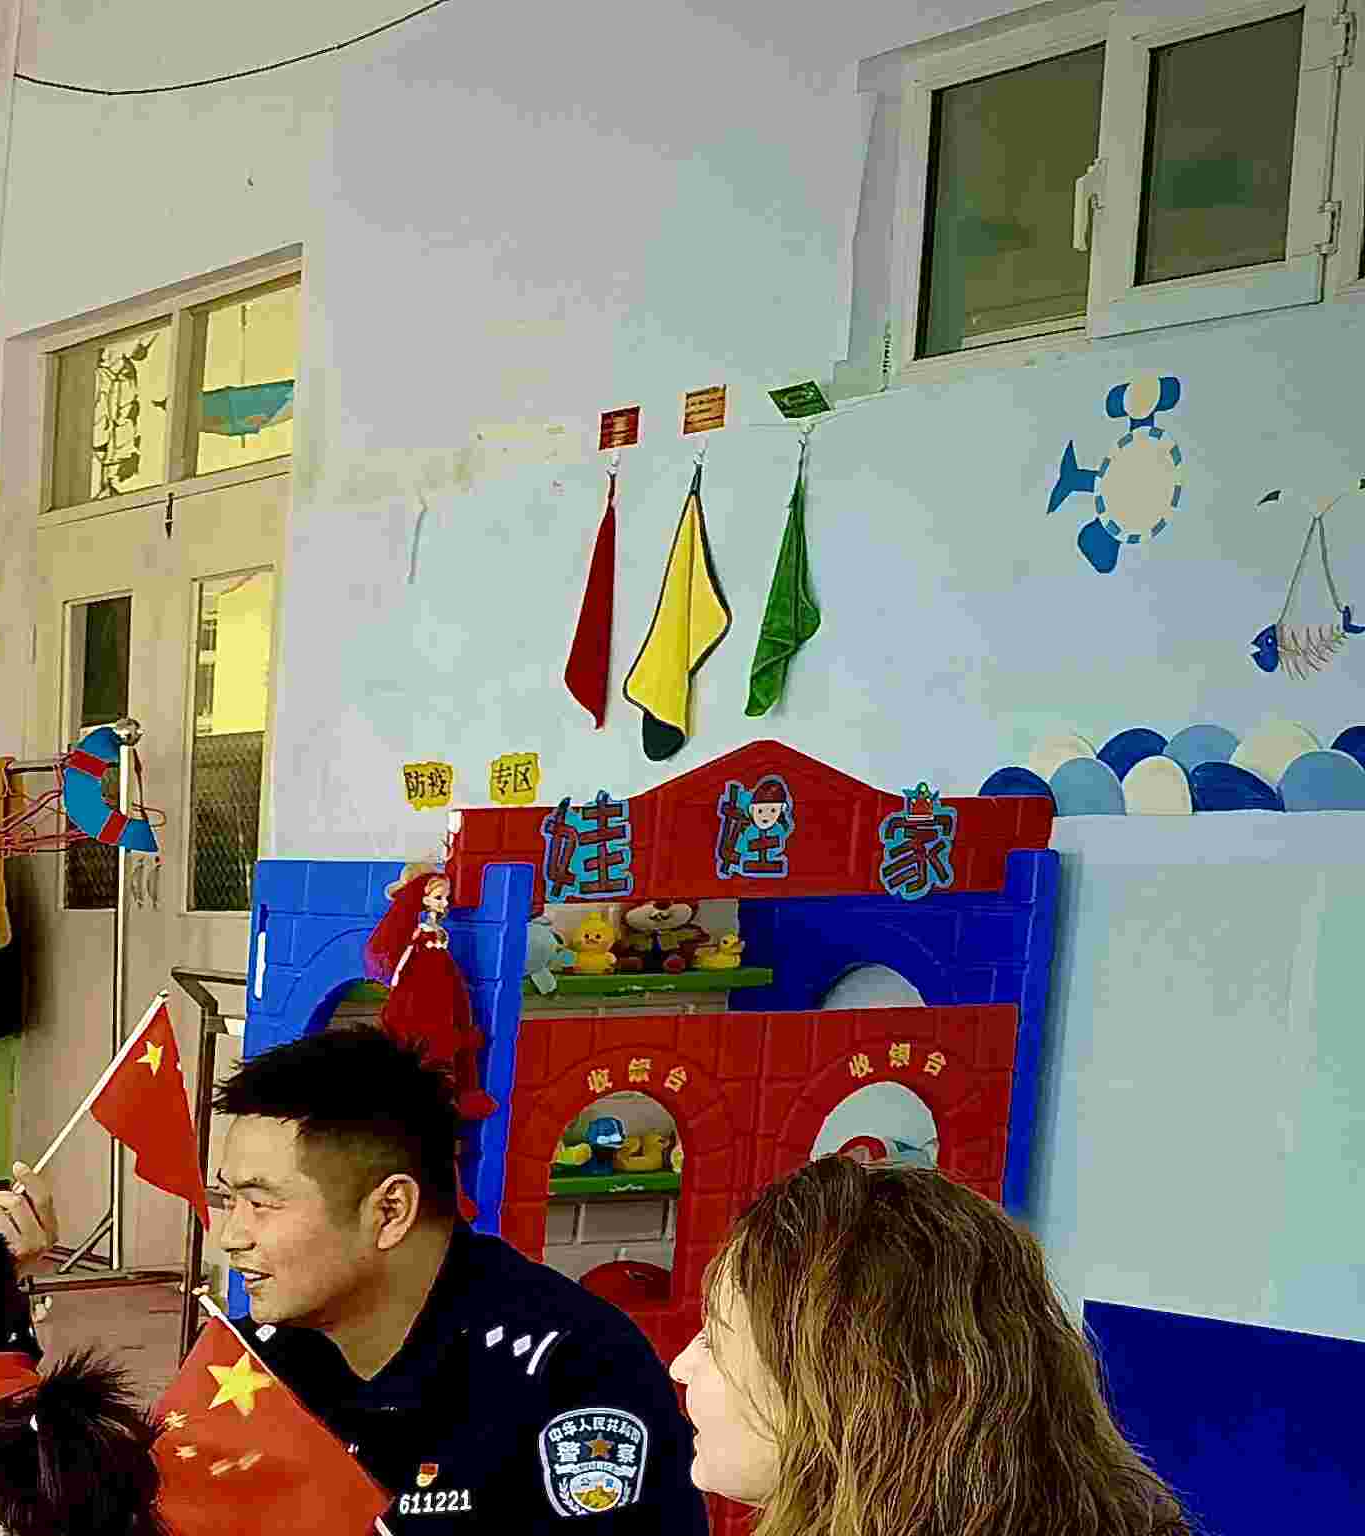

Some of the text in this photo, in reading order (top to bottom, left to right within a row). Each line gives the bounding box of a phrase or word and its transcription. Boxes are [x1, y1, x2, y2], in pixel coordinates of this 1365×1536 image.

[491, 760, 533, 796] 专区
[541, 780, 957, 901] 娃娃家
[556, 1440, 637, 1463] 警察
[399, 1488, 472, 1515] 611221
